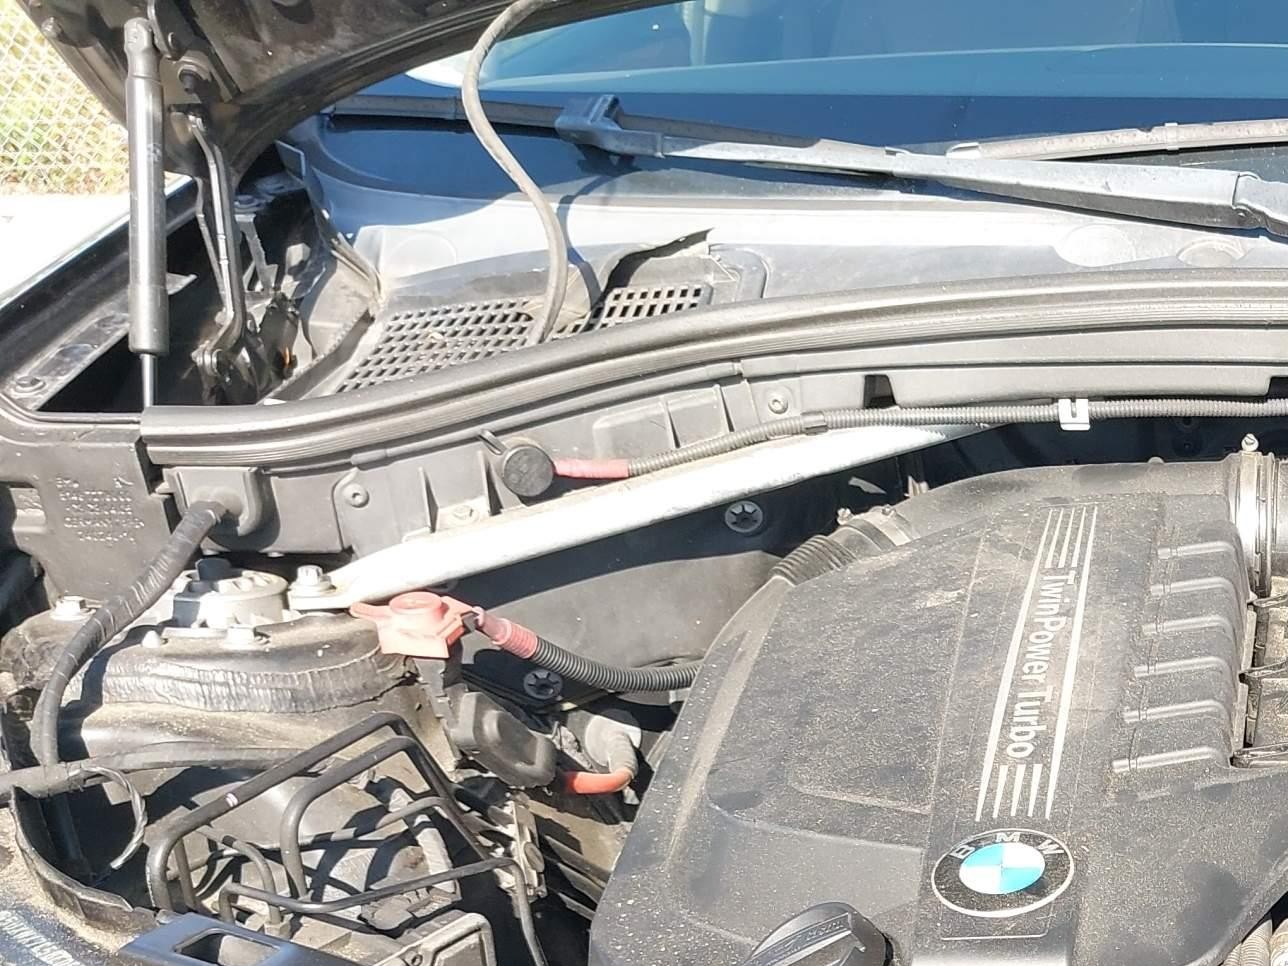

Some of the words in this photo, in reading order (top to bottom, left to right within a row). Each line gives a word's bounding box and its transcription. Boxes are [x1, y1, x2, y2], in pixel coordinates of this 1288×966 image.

[1021, 569, 1077, 684] TwinPower
[1006, 685, 1054, 759] Turbo
[950, 831, 1065, 860] BMW
